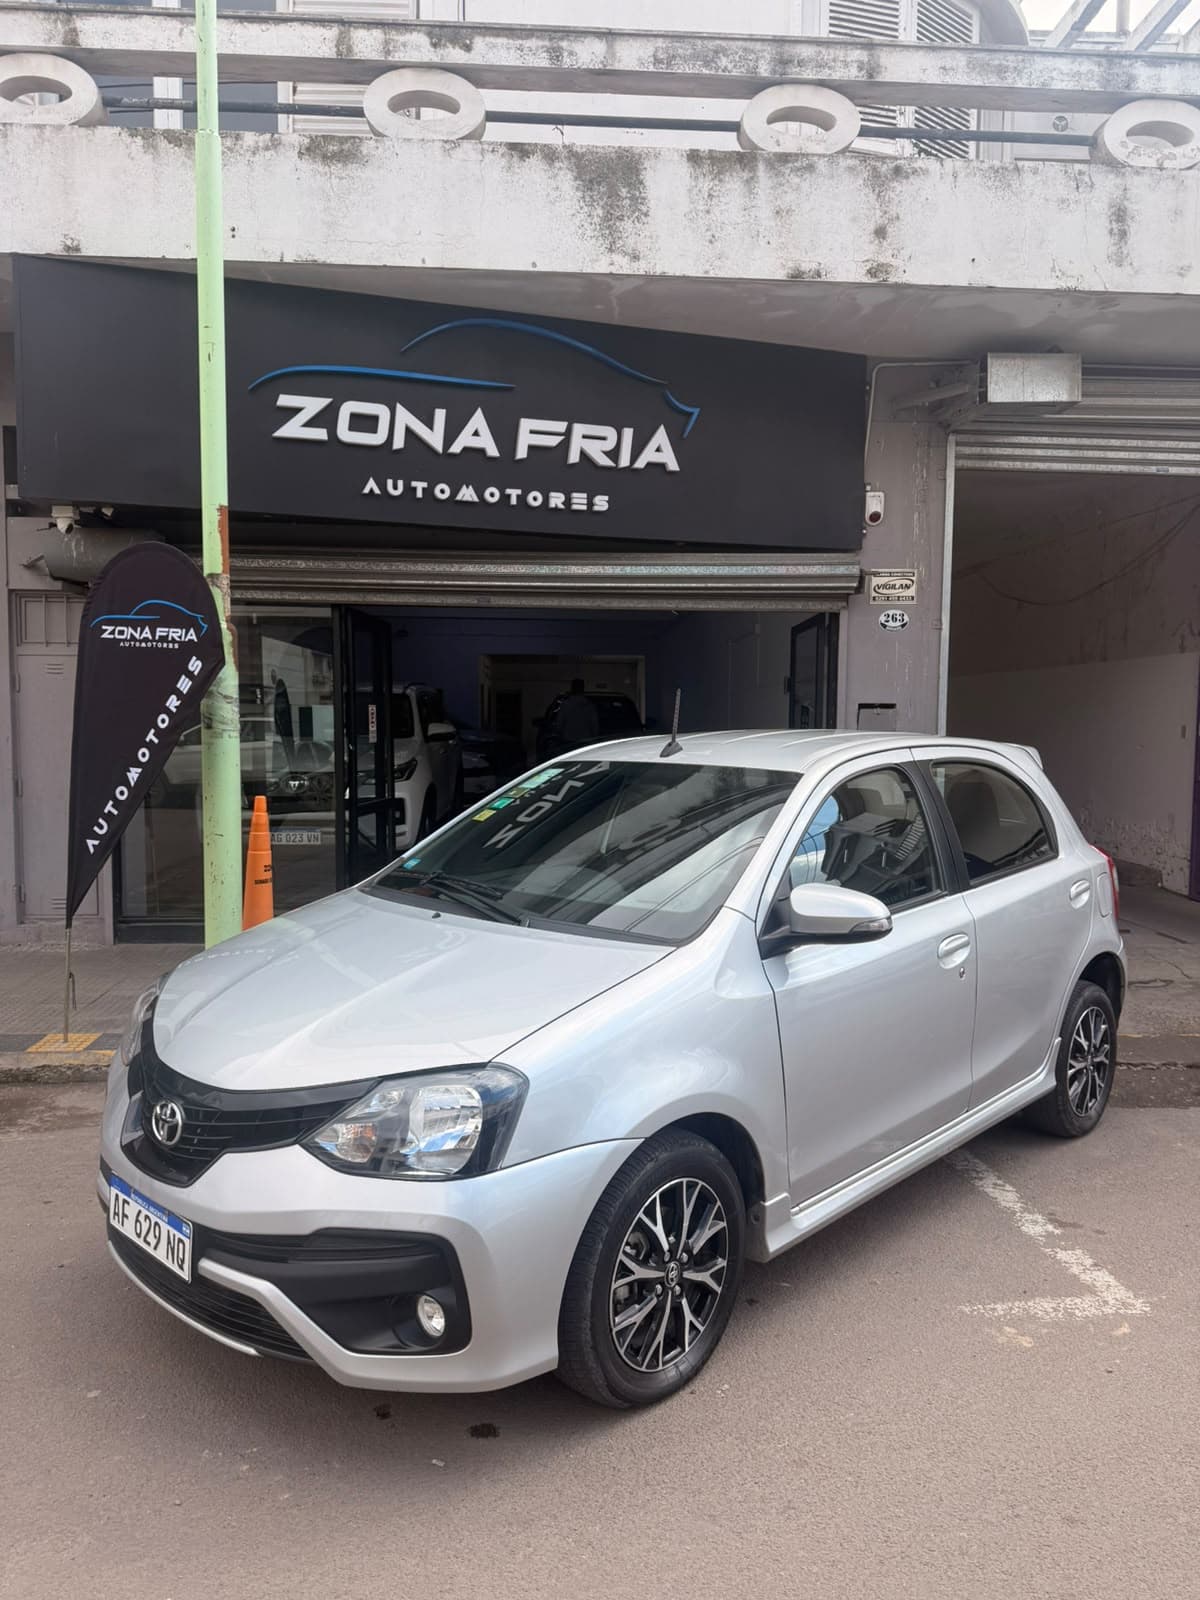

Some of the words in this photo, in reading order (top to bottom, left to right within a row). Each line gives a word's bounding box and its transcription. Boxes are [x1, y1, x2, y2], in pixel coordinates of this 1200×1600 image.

[272, 393, 500, 457] ZONA
[514, 417, 681, 472] FRIA
[362, 476, 610, 512] AUTOMOTORES
[883, 613, 905, 623] 263
[101, 625, 153, 640] ZONA
[155, 626, 198, 642] FRIA
[119, 641, 180, 649] AUTOMOTORES
[86, 655, 203, 856] AUTOMOTORES
[285, 833, 305, 844] 023
[307, 833, 320, 844] VN
[113, 1193, 130, 1228] AF
[134, 1209, 162, 1251] 629
[166, 1229, 186, 1273] NQ
